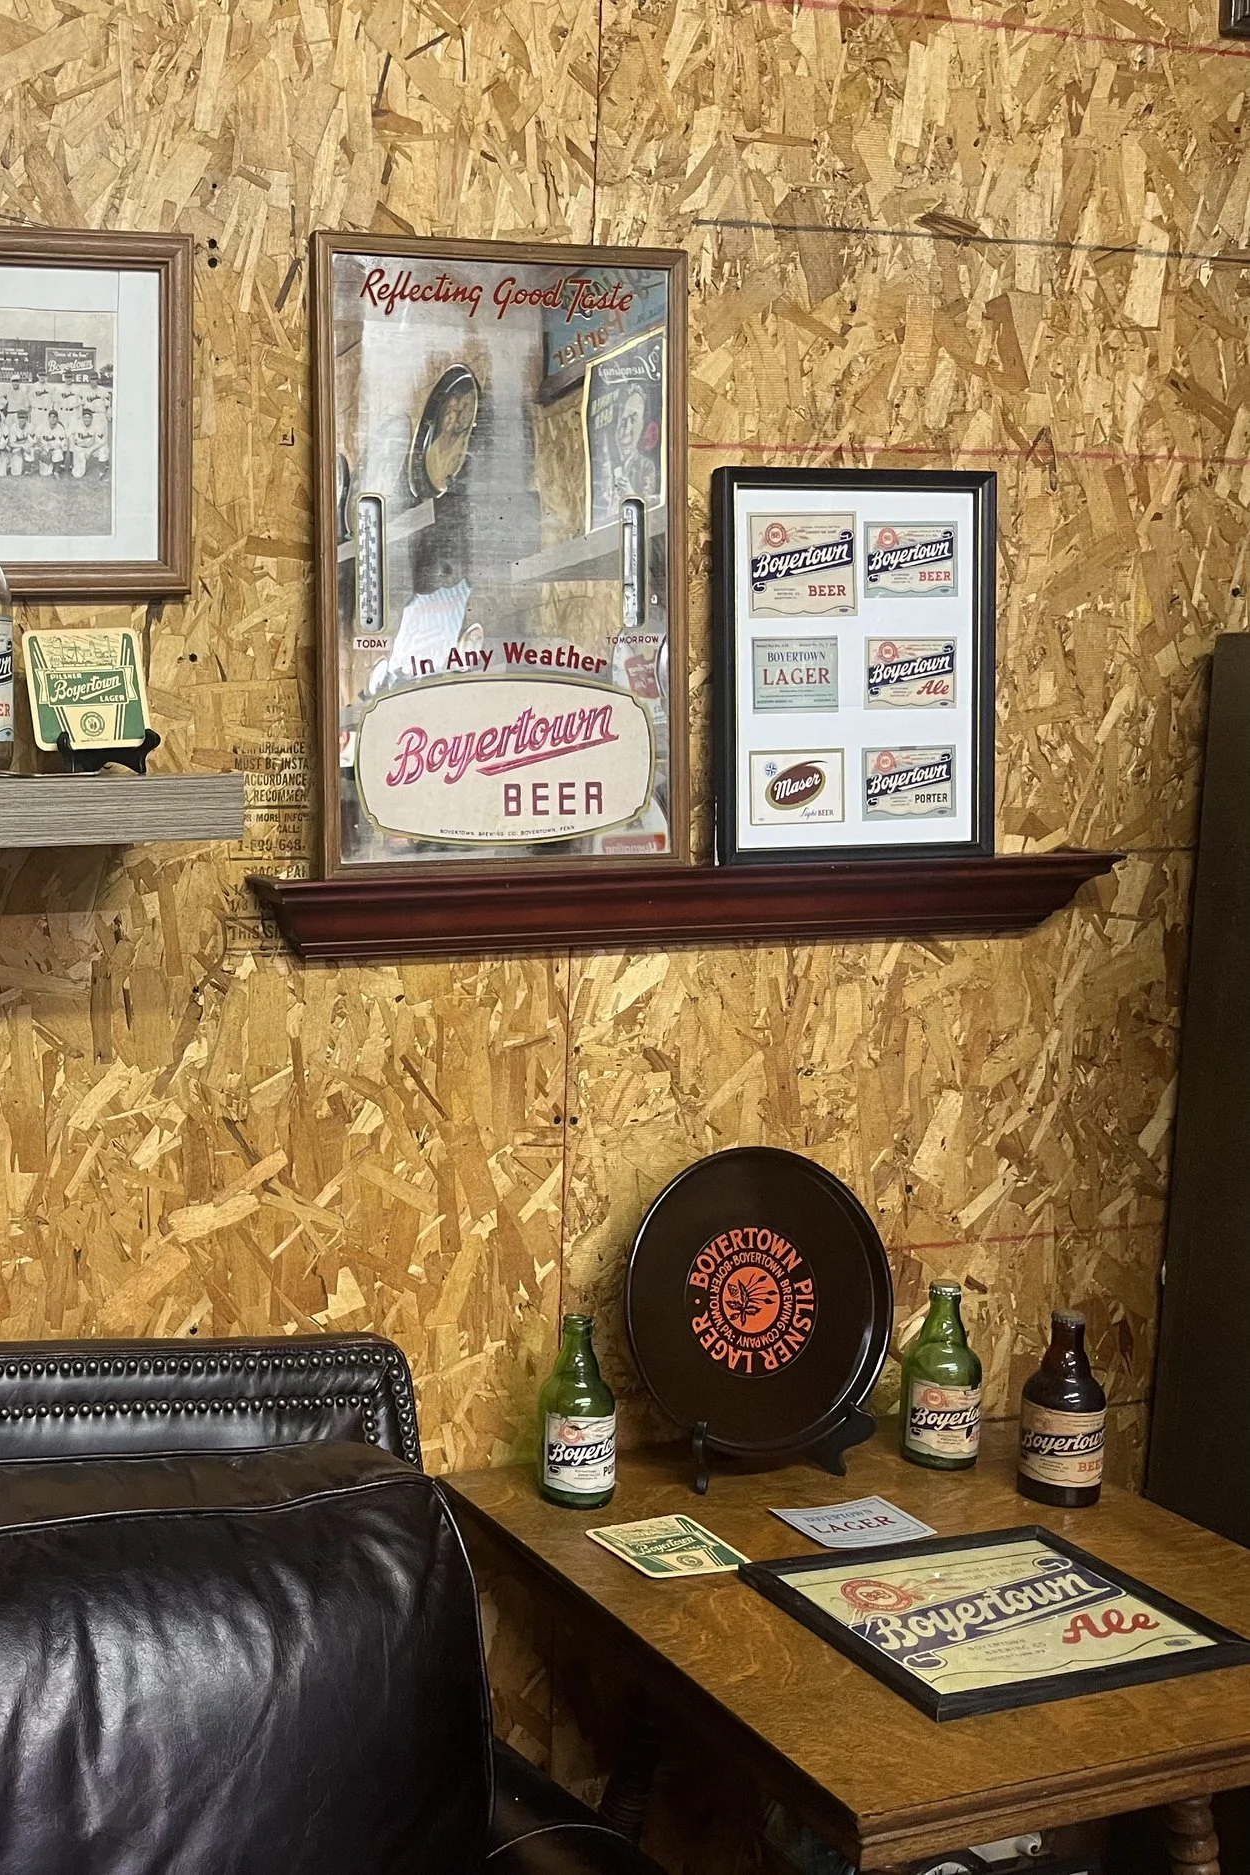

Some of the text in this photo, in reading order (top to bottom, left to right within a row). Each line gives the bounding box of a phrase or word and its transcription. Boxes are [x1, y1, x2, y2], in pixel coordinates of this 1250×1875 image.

[359, 268, 635, 324] Reflecting Good Taste
[753, 543, 852, 578] Boyertown
[868, 541, 953, 571] Boyertown
[918, 571, 951, 582] BEER
[807, 584, 847, 597] BEER
[356, 639, 388, 649] TODAY
[606, 635, 659, 645] TOMORROW
[410, 641, 608, 676] In Any Weather
[767, 651, 826, 662] BOYERTOWN
[50, 672, 82, 680] PILSNER
[763, 667, 831, 686] LAGER
[869, 655, 952, 684] Boyertown
[50, 675, 122, 703] Boyertown
[916, 679, 950, 695] Ale
[100, 694, 125, 703] LAGER
[385, 704, 619, 787] Boyertown
[234, 757, 263, 770] MUST
[244, 773, 307, 787] ACCORDANCE
[774, 771, 822, 801] Maser
[868, 763, 950, 795] Boyertown
[504, 781, 603, 817] BEER
[914, 793, 948, 804] PORTER
[256, 812, 280, 822] MORE
[440, 828, 475, 836] BOYERTOWN
[689, 1227, 815, 1374] BOYERTOWN PILSNER LAGER
[732, 1251, 793, 1349] BOYERTOWN BREWING COMPANY
[910, 1406, 981, 1431] Boyerto
[1021, 1428, 1106, 1455] Boyertow
[548, 1438, 615, 1467] Boyerto
[1077, 1460, 1103, 1473] BEE
[802, 1508, 874, 1522] BOYERTOWN
[809, 1515, 897, 1534] LAGER
[636, 1536, 697, 1555] Boyertown
[875, 1573, 1112, 1650] Boyertown
[1062, 1608, 1161, 1645] Ale
